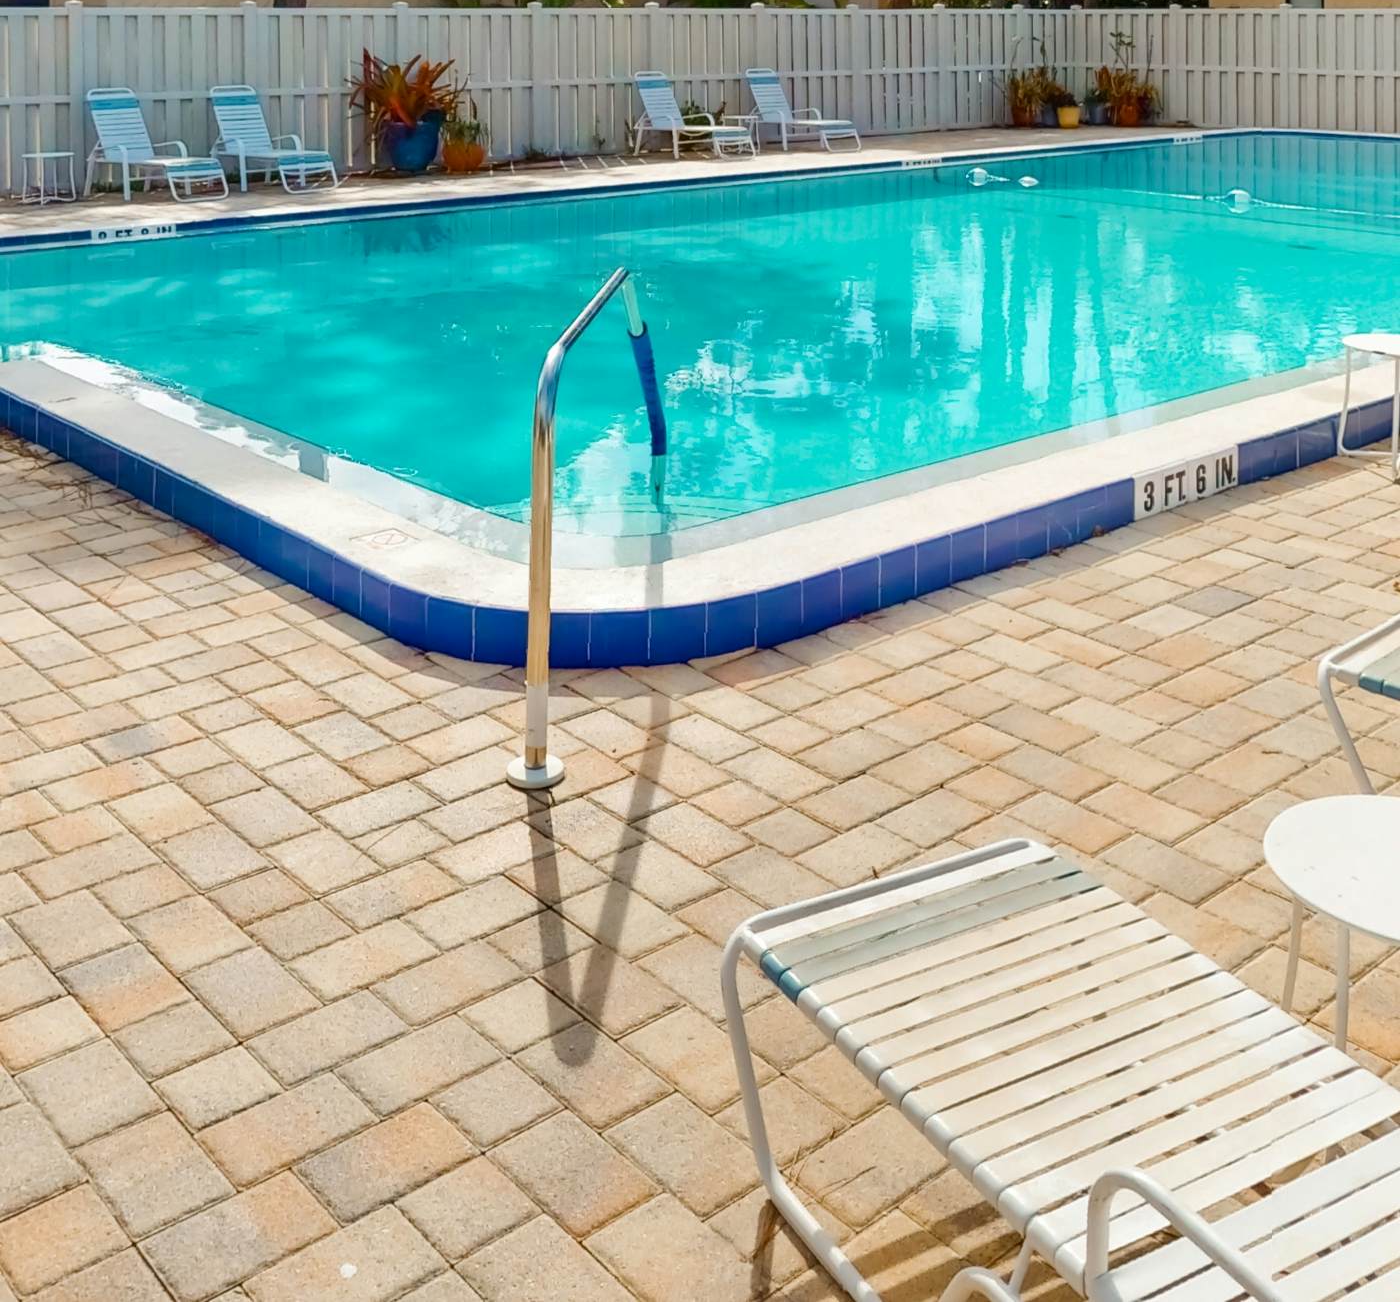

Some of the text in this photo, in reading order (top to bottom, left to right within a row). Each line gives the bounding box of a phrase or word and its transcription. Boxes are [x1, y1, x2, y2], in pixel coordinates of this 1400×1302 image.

[1144, 455, 1236, 512] 3 FT. 6 IN.
